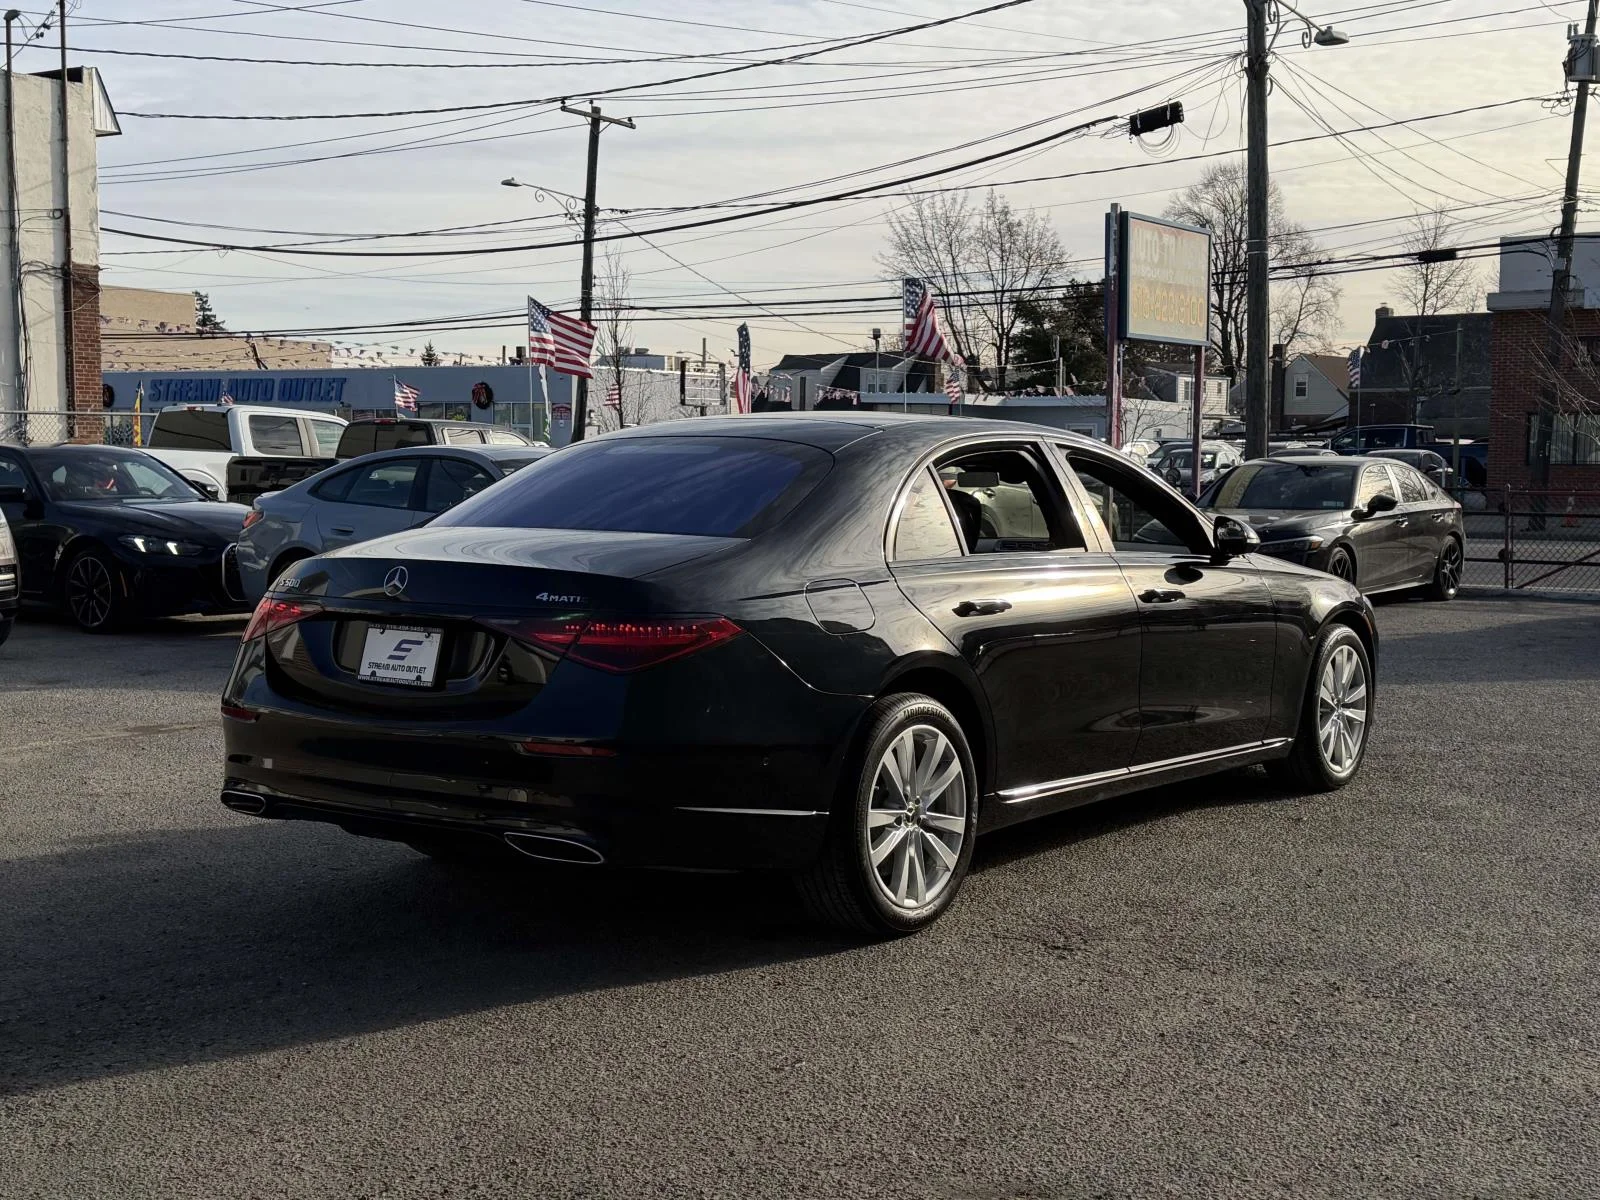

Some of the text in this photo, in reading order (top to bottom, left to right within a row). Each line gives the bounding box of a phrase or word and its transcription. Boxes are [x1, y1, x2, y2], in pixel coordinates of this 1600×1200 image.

[150, 378, 347, 402] STREAM AUTO OUTLET
[535, 592, 590, 603] 4MATI
[368, 662, 427, 674] STREAM AUTO OUTLET
